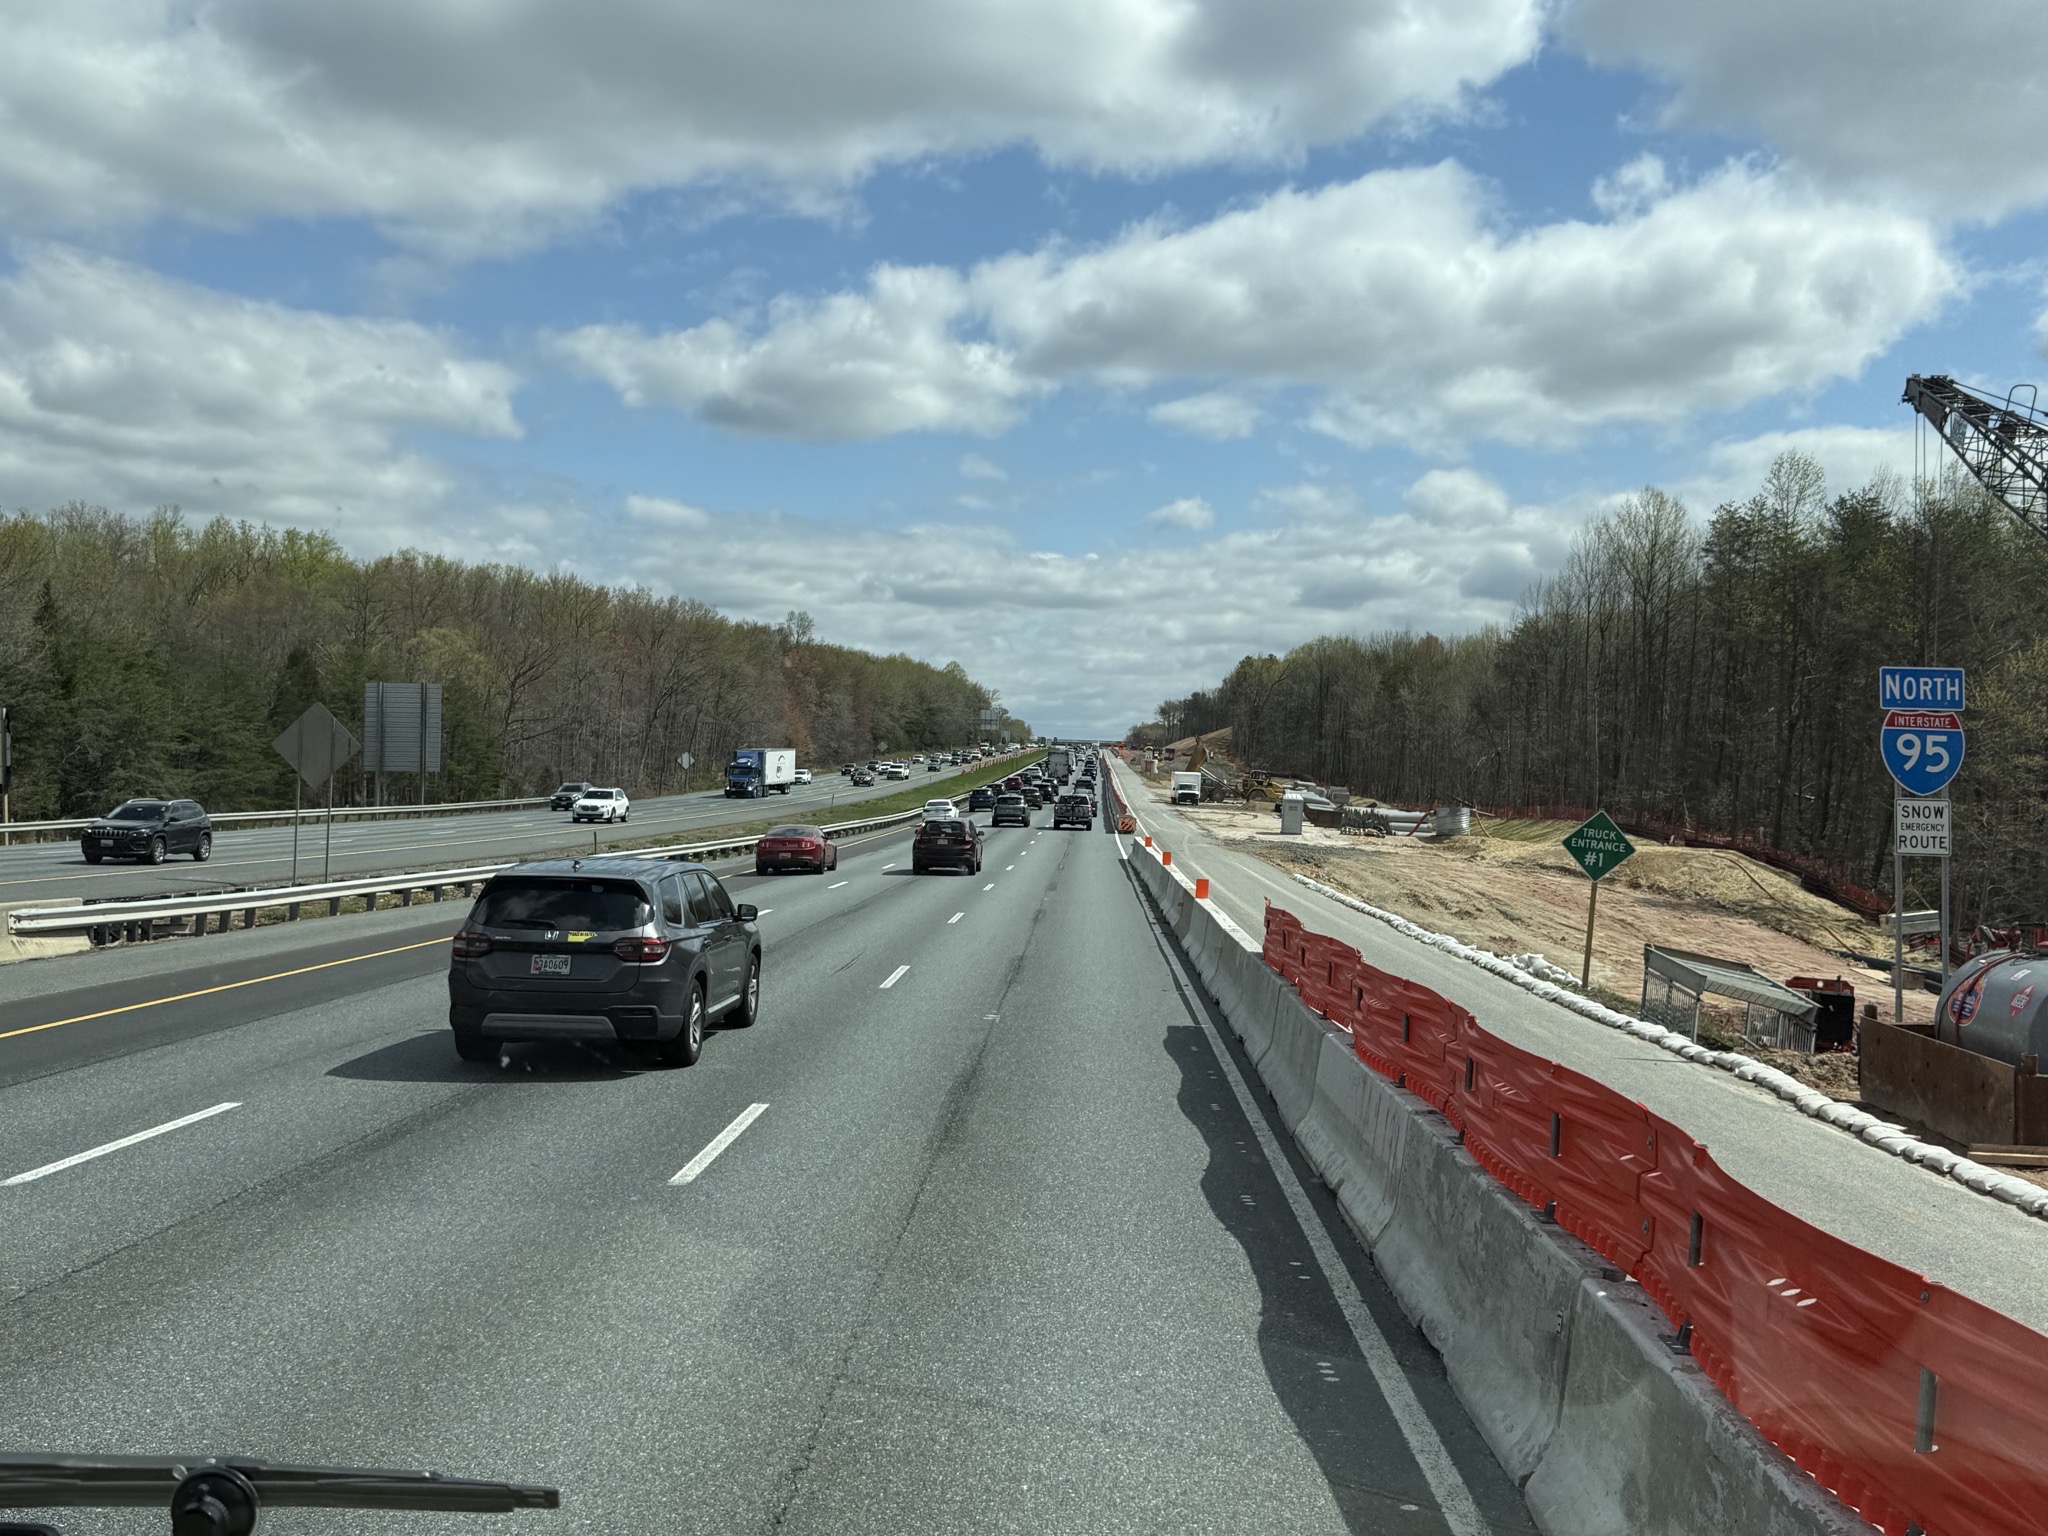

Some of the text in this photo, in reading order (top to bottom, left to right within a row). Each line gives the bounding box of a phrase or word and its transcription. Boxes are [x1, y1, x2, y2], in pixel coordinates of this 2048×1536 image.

[1885, 674, 1960, 701] NORTH
[1894, 716, 1951, 728] INTERSTATE
[1896, 733, 1950, 773] 95
[1901, 805, 1945, 819] SNOW
[1582, 827, 1617, 840] TRUCK
[1900, 822, 1945, 832] EMERGENCY
[1571, 837, 1627, 853] ENTRANCE
[1899, 835, 1947, 850] ROUTE
[1584, 851, 1604, 867] #1
